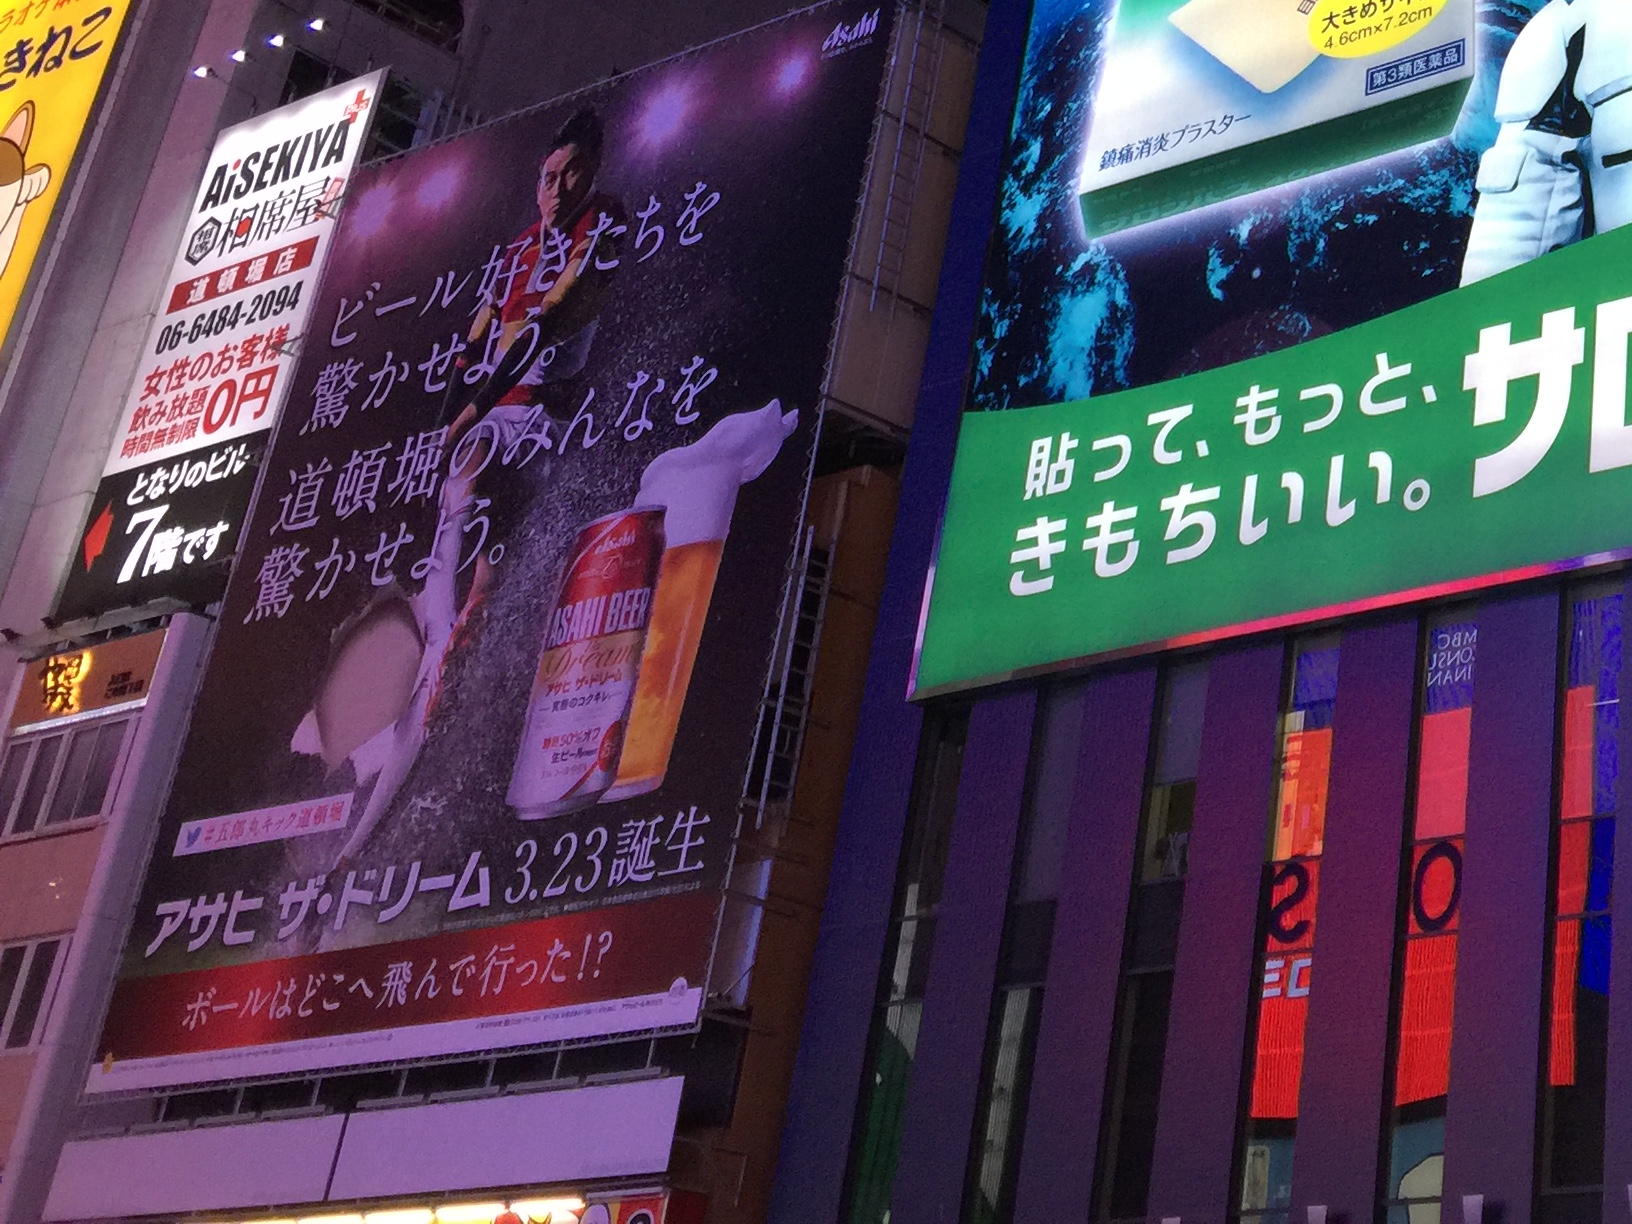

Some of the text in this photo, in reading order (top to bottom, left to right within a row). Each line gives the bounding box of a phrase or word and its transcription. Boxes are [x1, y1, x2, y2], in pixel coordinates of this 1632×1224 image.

[822, 8, 880, 51] Asahi
[1372, 47, 1460, 87] 第3類医薬品
[1098, 113, 1252, 171] 鎮痛消炎プラスター
[186, 247, 298, 305] 道頓堀店
[331, 180, 722, 350] ビール好きたちを
[155, 281, 303, 355] 06-6484-2094
[139, 324, 290, 402] 女性のお客様
[299, 309, 558, 437] 驚かせよう。
[127, 385, 211, 434] 飲み放題
[203, 364, 280, 435] 0円
[119, 417, 201, 460] 時間無制限
[126, 443, 251, 506] となりのビル
[269, 356, 720, 537] 道頓堀のみんなを
[117, 504, 229, 584] 7階です
[1008, 450, 1431, 596] きもちいい。
[243, 498, 506, 626] 驚かせよう。
[547, 587, 650, 649] ASAHI BEER
[145, 889, 265, 958] アサヒ
[278, 850, 490, 940] ザ・ドリーム
